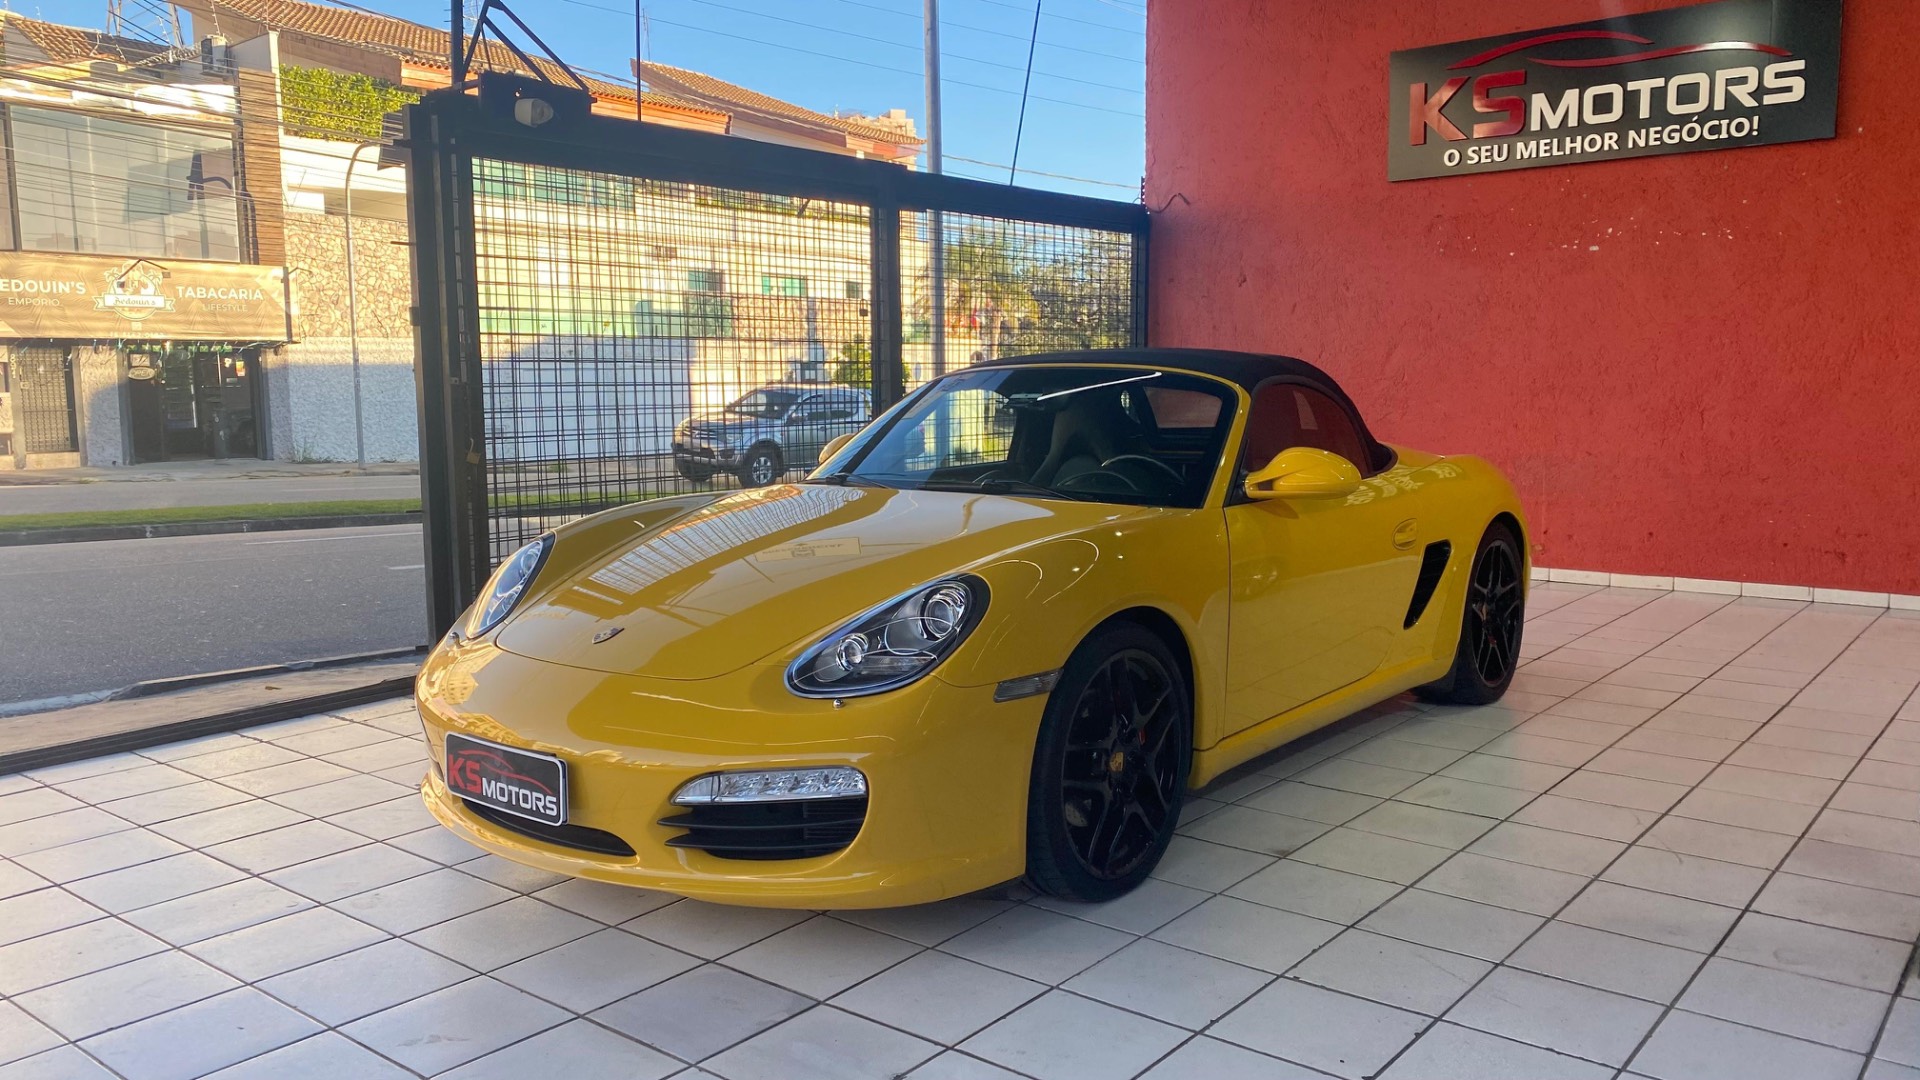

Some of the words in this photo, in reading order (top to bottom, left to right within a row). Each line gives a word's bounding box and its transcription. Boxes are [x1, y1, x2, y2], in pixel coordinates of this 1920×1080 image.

[1409, 69, 1527, 146] KS
[1530, 59, 1807, 132] MOTORS
[1443, 148, 1461, 167] O
[1467, 142, 1509, 165] SEU
[1516, 131, 1620, 161] MELHOR
[1627, 115, 1760, 149] NEGÓCIO!
[175, 286, 264, 301] TABACARIA
[202, 303, 249, 312] LIFESTYLE
[447, 753, 482, 794] KS
[481, 777, 558, 817] MOTORS
